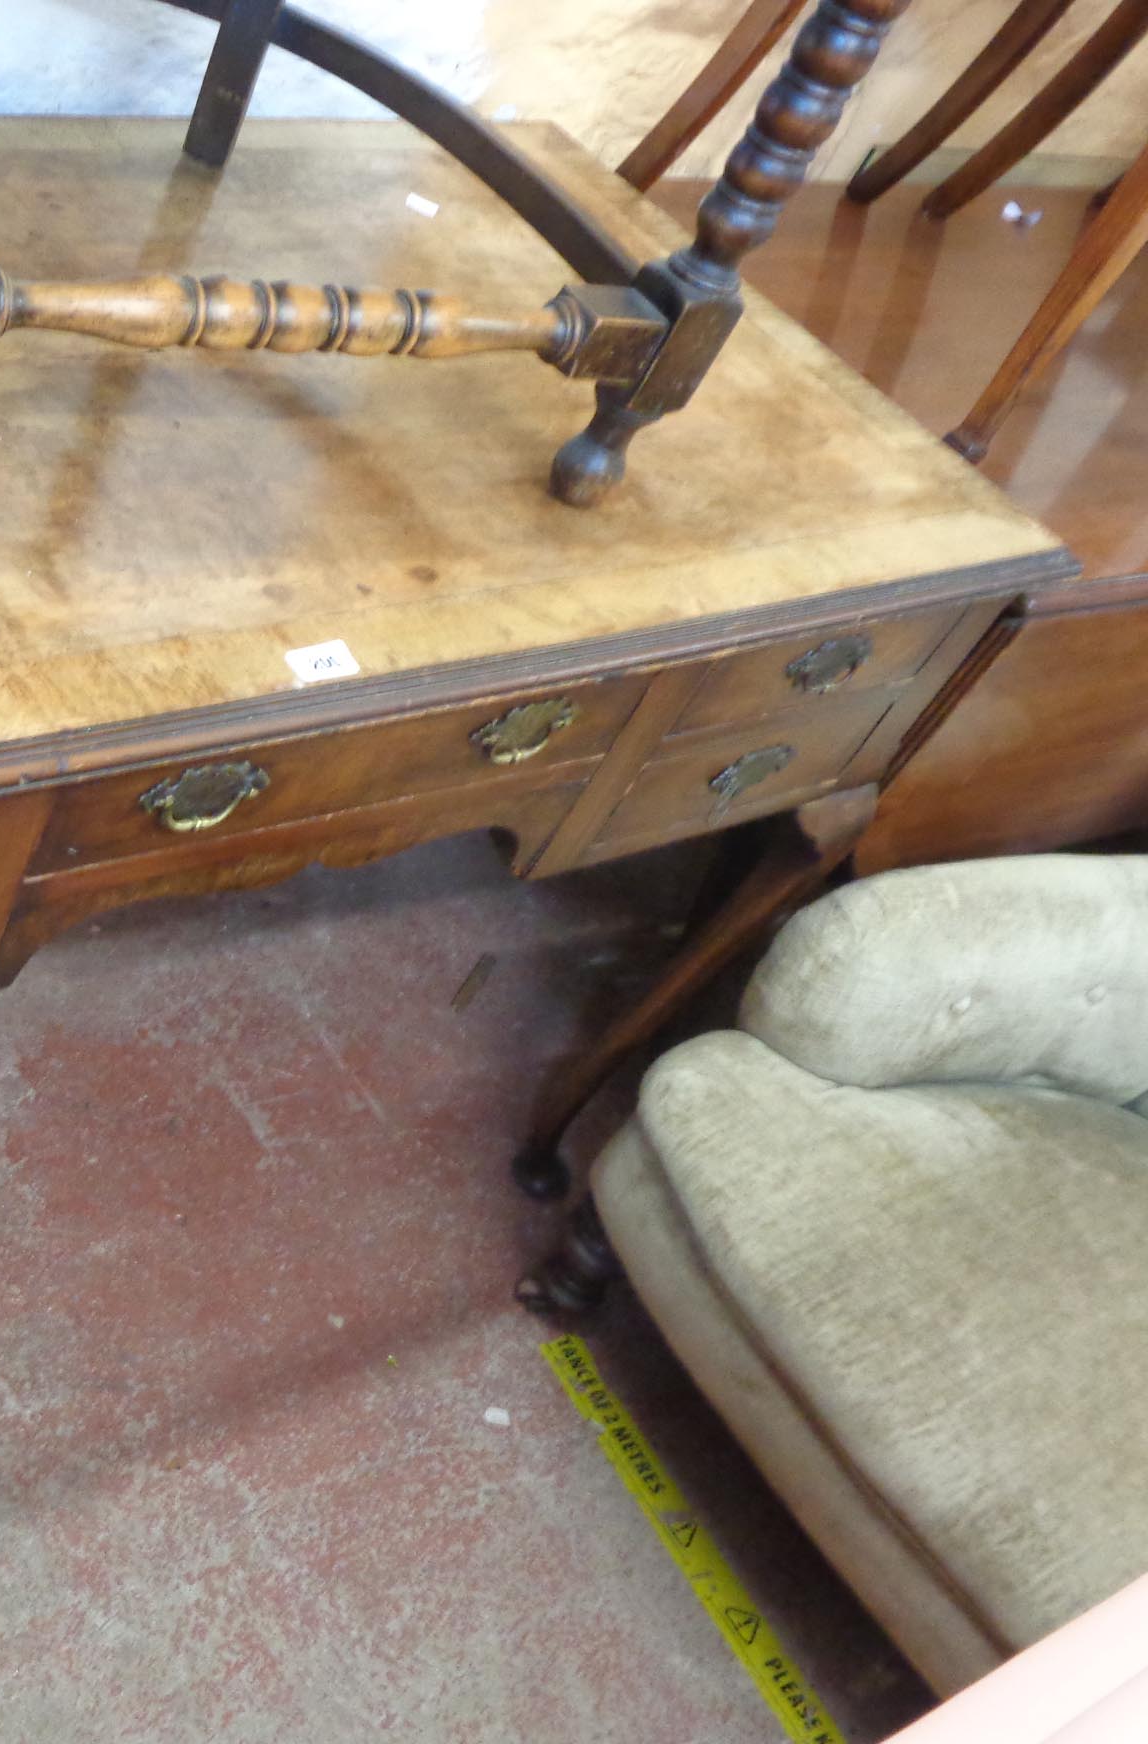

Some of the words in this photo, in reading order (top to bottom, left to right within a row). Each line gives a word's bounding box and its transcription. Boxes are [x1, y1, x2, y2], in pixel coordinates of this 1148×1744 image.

[603, 1413, 620, 1425] 2
[612, 1426, 665, 1494] METRES
[764, 1657, 822, 1730] PLEASE
